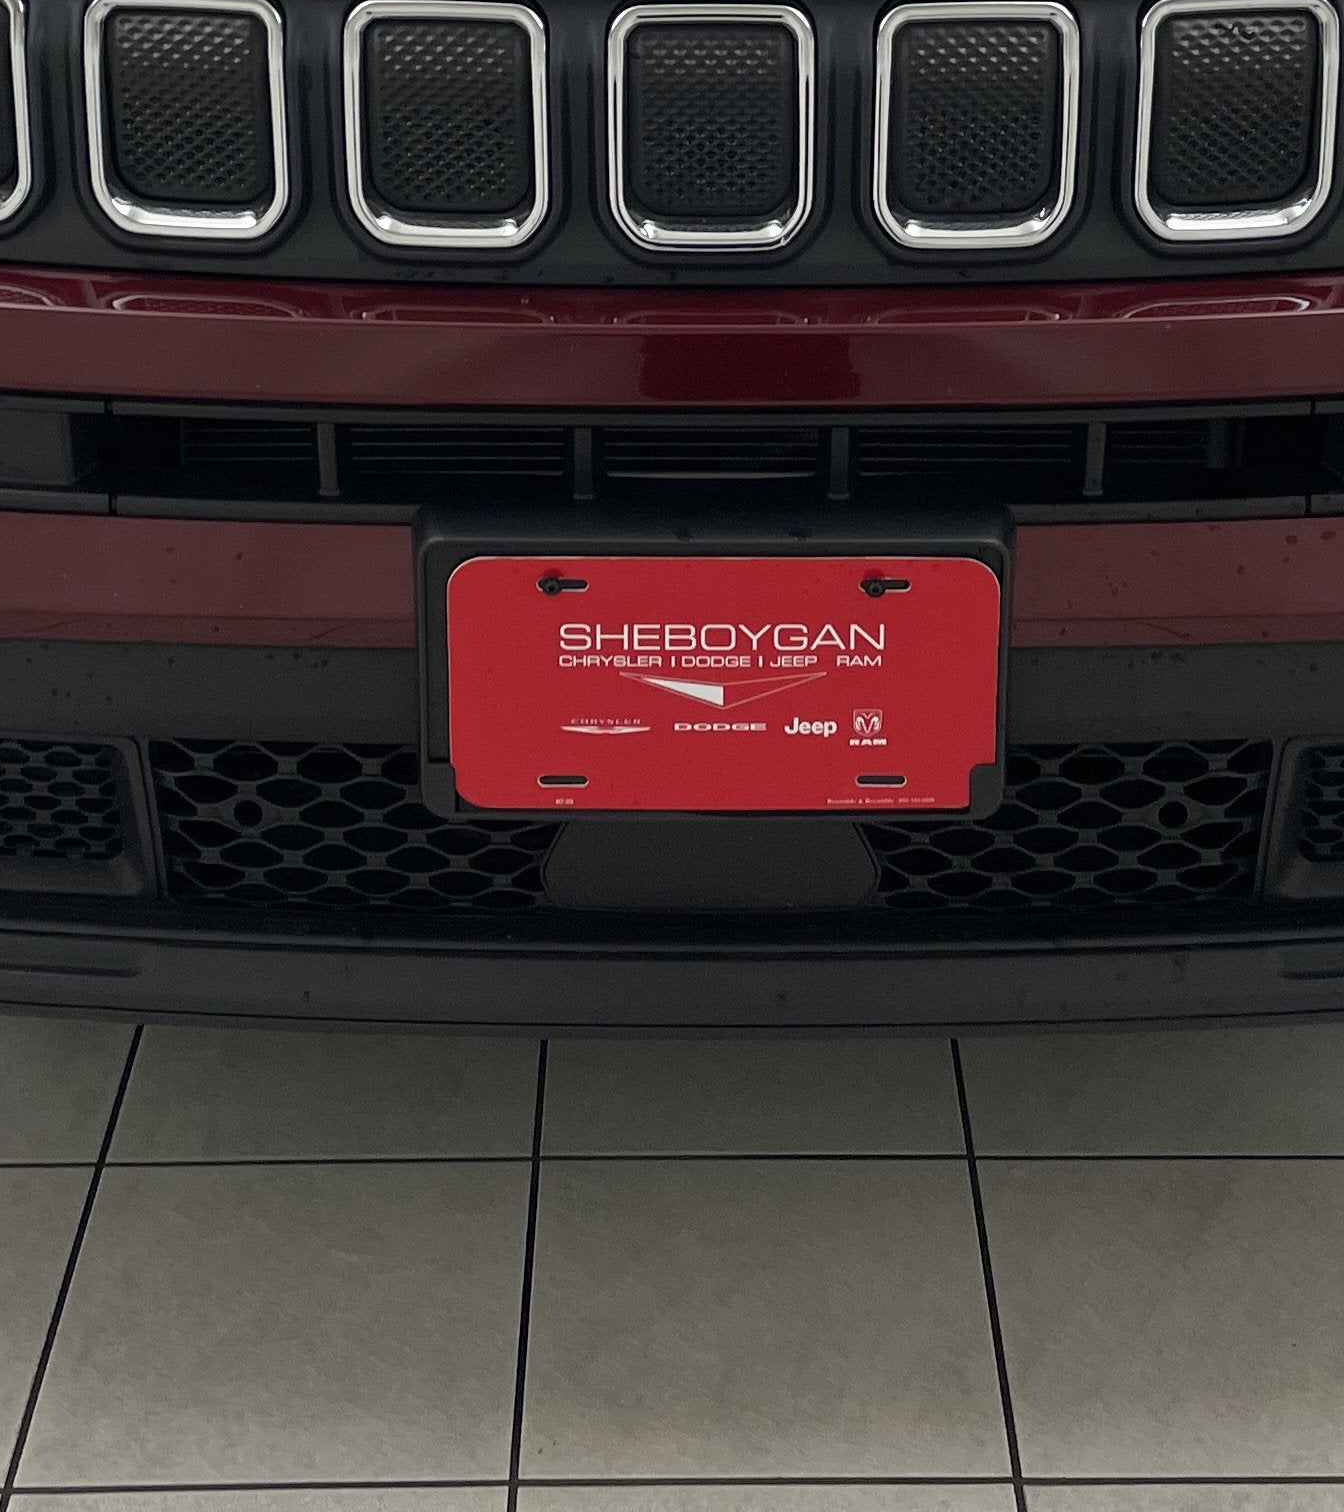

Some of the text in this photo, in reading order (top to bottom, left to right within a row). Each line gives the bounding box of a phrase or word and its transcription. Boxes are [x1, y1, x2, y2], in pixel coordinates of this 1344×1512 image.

[559, 623, 885, 651] SHEBOYGAN
[559, 655, 663, 668] CHRYSLER
[681, 655, 752, 668] DODGE
[769, 655, 818, 667] JEEP
[836, 655, 882, 667] RAM
[673, 722, 767, 732] DODGE
[784, 717, 838, 738] Jeep
[849, 738, 888, 746] RAM
